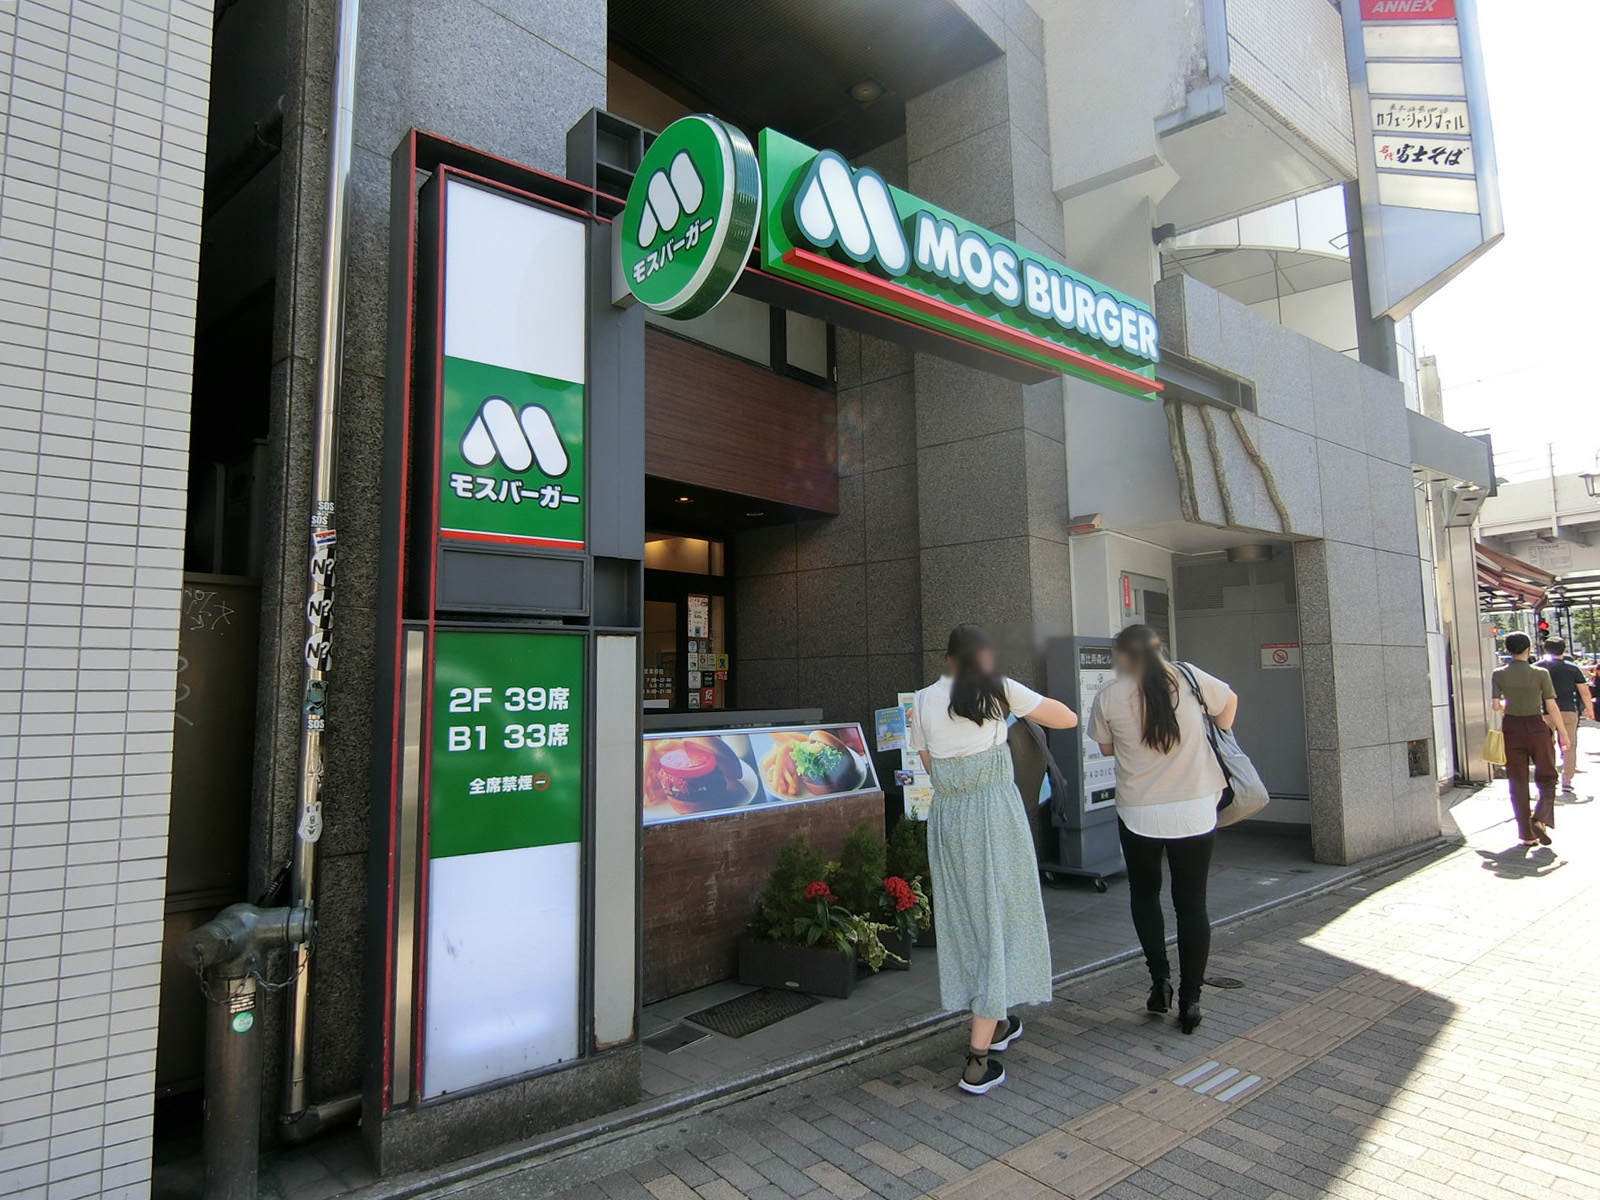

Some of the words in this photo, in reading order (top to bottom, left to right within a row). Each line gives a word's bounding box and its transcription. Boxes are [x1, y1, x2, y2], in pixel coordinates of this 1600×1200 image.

[1372, 0, 1437, 13] ANNEX
[1396, 143, 1470, 166] 富士そば
[632, 217, 714, 284] モスバーガー
[917, 215, 1021, 304] MOS
[1024, 261, 1159, 363] BURGER
[450, 473, 580, 509] モスバーガー
[318, 501, 335, 511] SOS
[311, 515, 328, 525] SOS
[448, 687, 493, 713] 2F
[504, 687, 570, 712] 39席
[307, 719, 325, 729] SOS
[448, 725, 487, 752] B1
[503, 723, 570, 749] 33席
[469, 774, 534, 796] 全席禁煙
